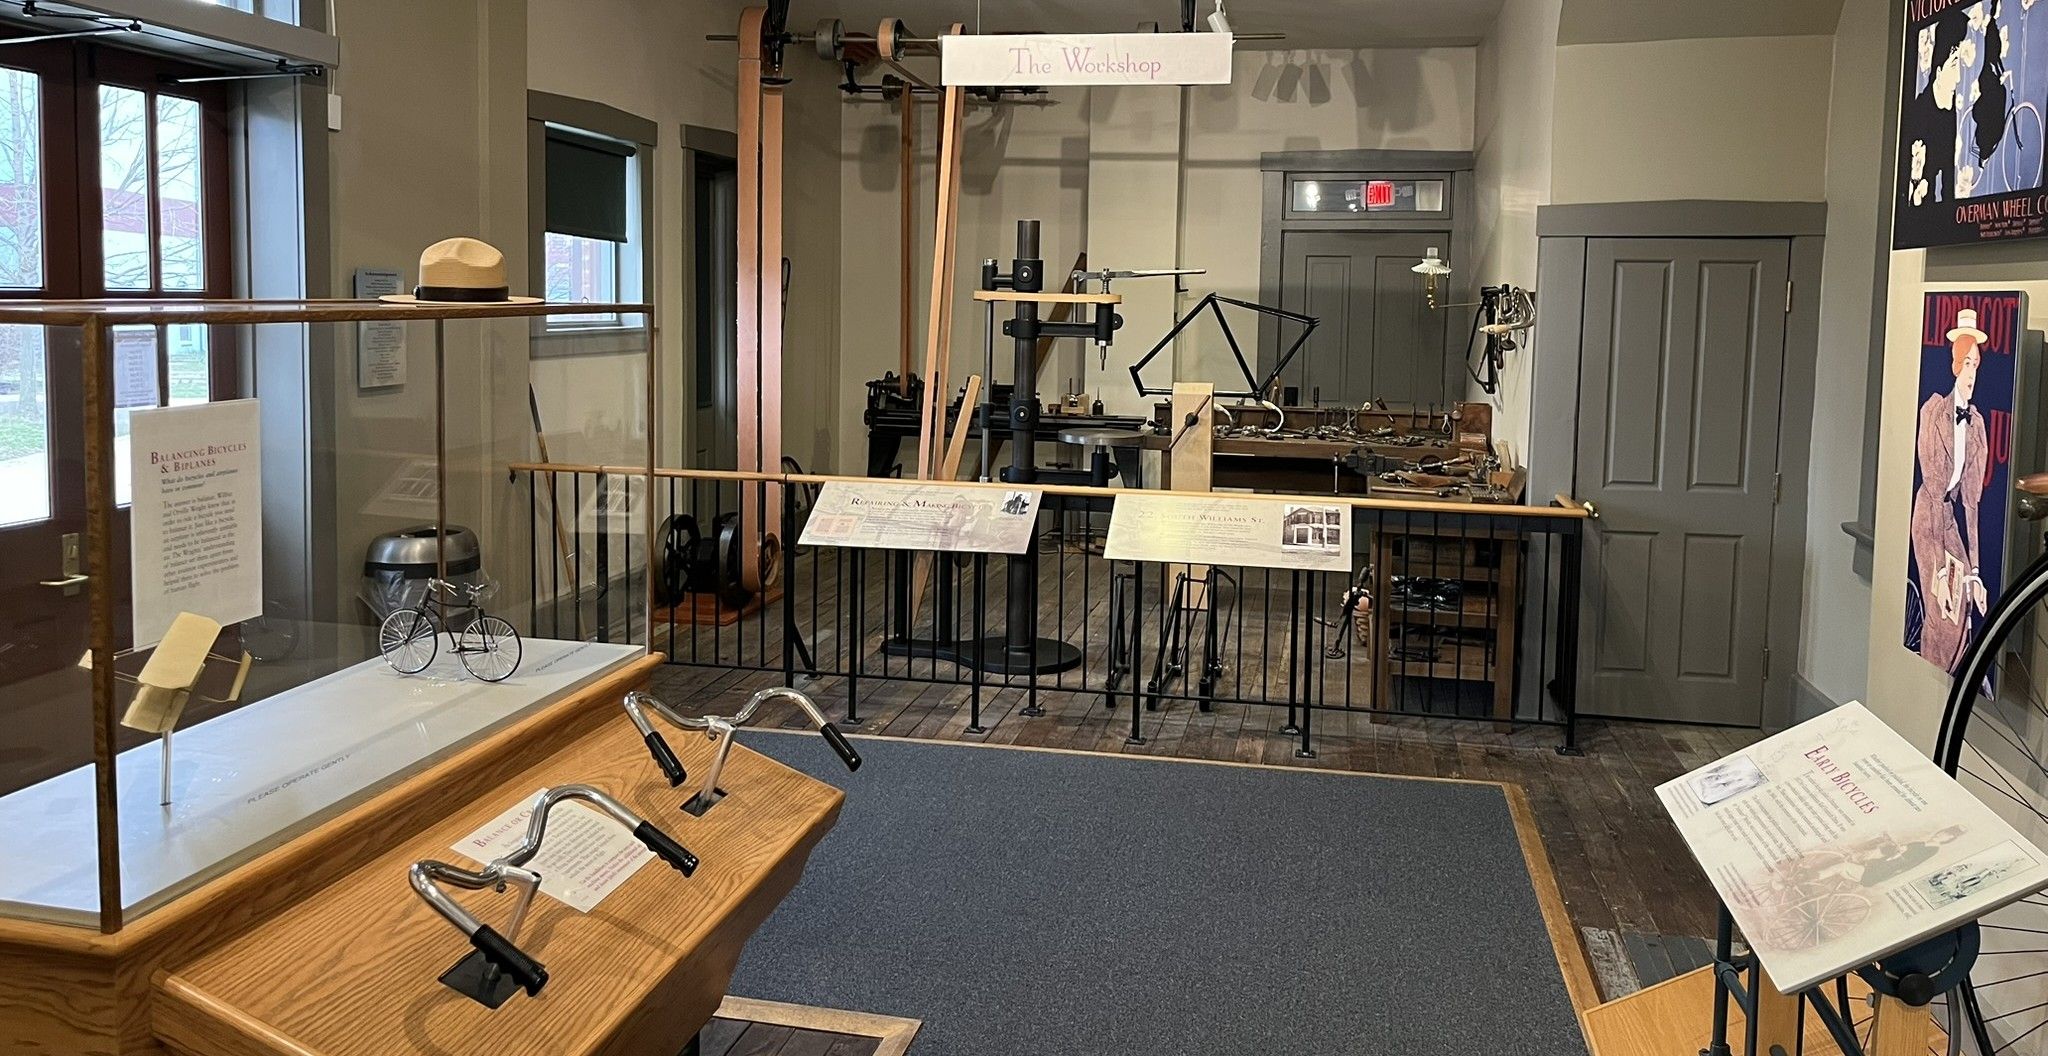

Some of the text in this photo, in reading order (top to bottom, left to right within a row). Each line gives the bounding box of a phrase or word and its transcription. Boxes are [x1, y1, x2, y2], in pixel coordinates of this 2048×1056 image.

[1009, 46, 1161, 79] The Workshop
[1367, 184, 1391, 204] EXIT
[1956, 201, 2000, 224] OVERMAN
[2003, 197, 2034, 218] WHEEL
[151, 443, 246, 465] BALANCING BICYCLES
[161, 459, 216, 473] & BIPLANES
[248, 786, 280, 804] PLEASE
[281, 768, 319, 788] OPERATE
[1804, 745, 1840, 775] EARLY
[1831, 771, 1879, 814] BICYCLES
